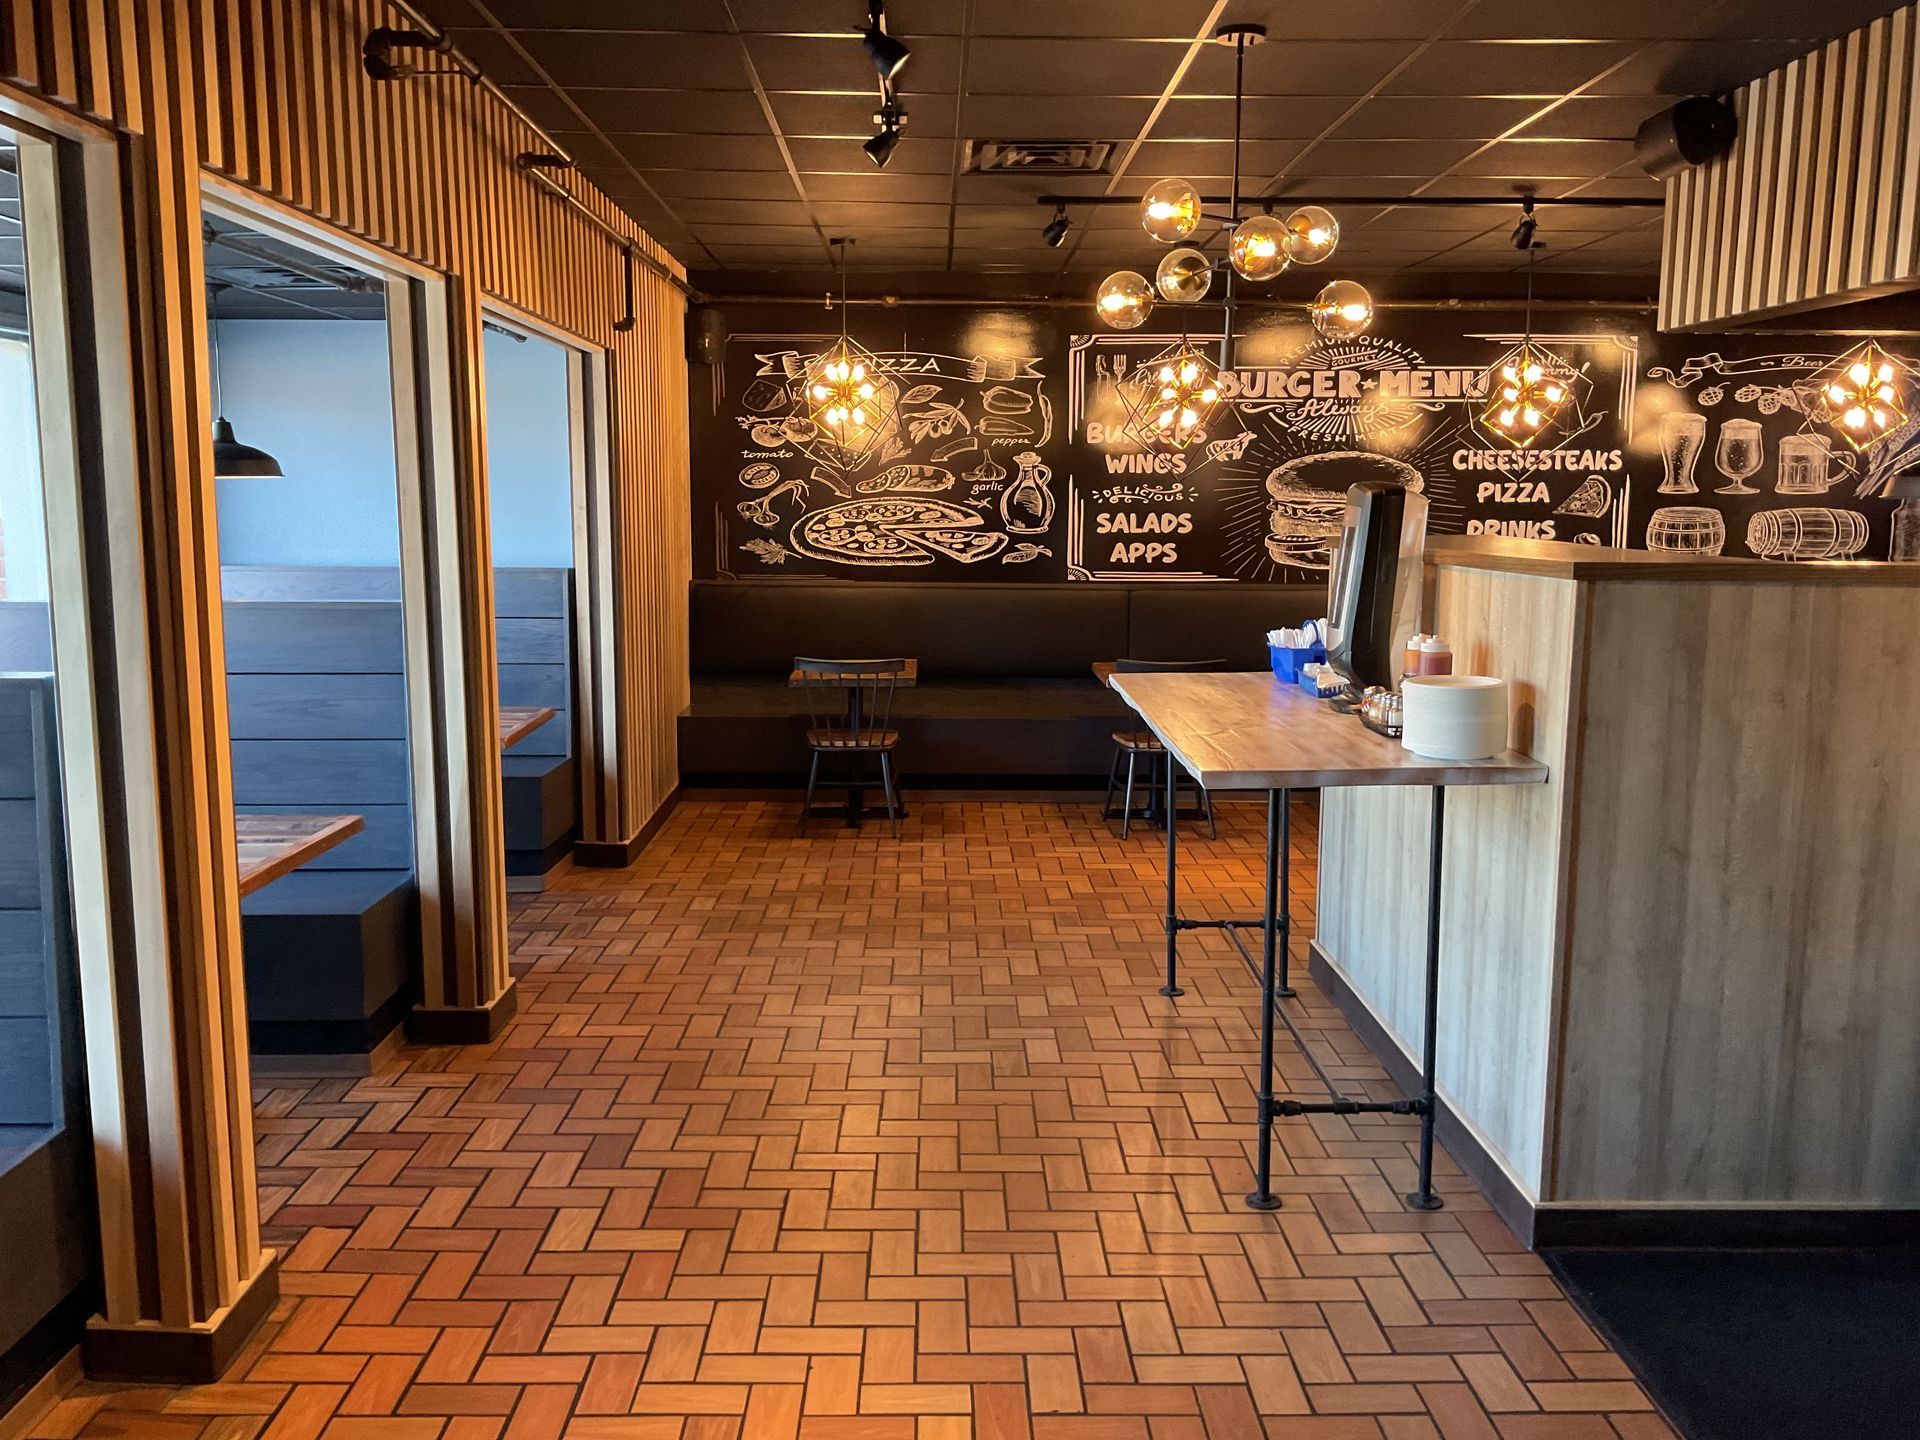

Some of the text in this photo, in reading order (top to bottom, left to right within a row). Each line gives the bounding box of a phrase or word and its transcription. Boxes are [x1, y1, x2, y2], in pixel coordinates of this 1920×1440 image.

[1331, 353, 1377, 367] GOURMET
[1358, 335, 1426, 364] QUALITY
[1781, 355, 1825, 368] Beer
[1217, 370, 1362, 399] BURGER
[1379, 370, 1491, 397] MENU
[1285, 398, 1390, 423] Always
[1287, 425, 1397, 442] FRESH MEAT
[741, 448, 794, 459] tomato
[1105, 454, 1188, 474] WINGS
[1452, 449, 1623, 472] CHEESESTEAKS
[970, 481, 1004, 495] garlic
[1102, 485, 1184, 502] DELICIOUS
[1476, 482, 1550, 503] PIZZA
[1096, 512, 1193, 534] SALADS
[1466, 519, 1557, 540] DRINKS
[1109, 542, 1178, 564] APPS
